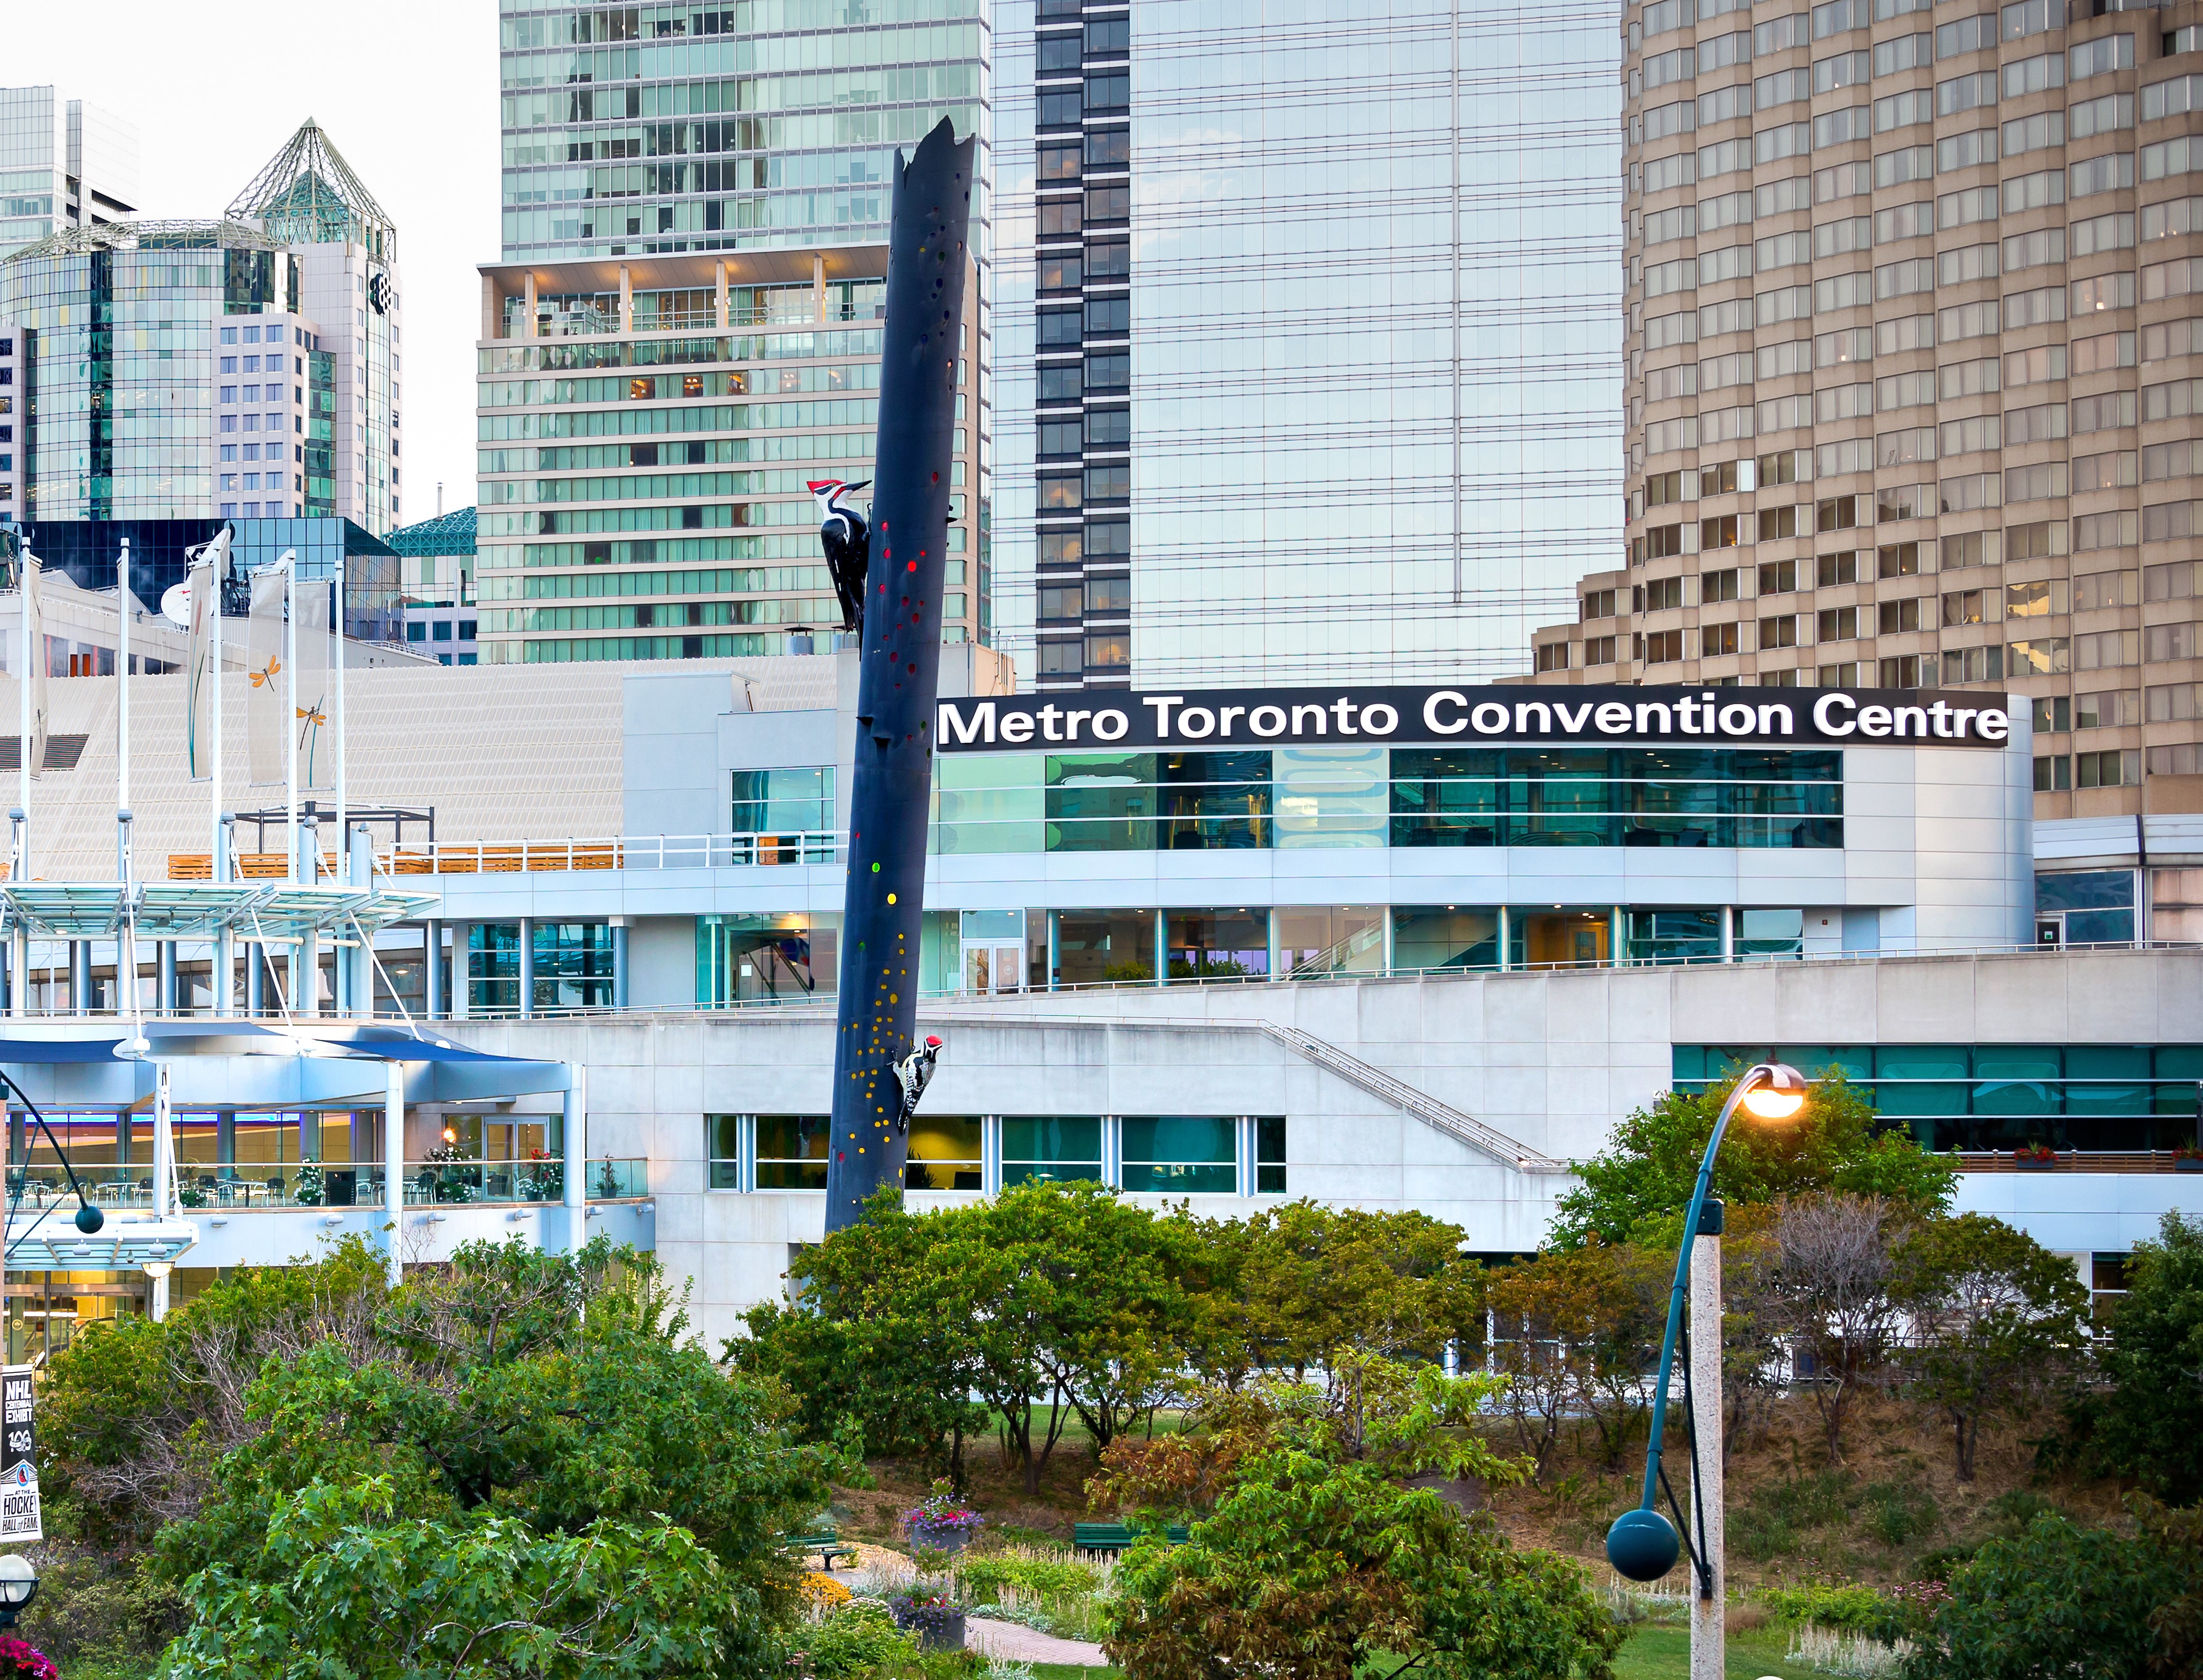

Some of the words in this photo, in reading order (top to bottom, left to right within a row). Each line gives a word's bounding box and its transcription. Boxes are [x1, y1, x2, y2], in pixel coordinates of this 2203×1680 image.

[937, 702, 1129, 744] Metro
[1143, 696, 1399, 738] Toronto
[1424, 691, 1793, 735] Convention
[1813, 693, 2009, 741] Centre
[6, 1380, 32, 1401] NHL
[6, 1408, 33, 1423] EXHIBIT
[4, 1495, 37, 1515] HOCKEY
[3, 1519, 17, 1532] HALL
[17, 1520, 24, 1532] of
